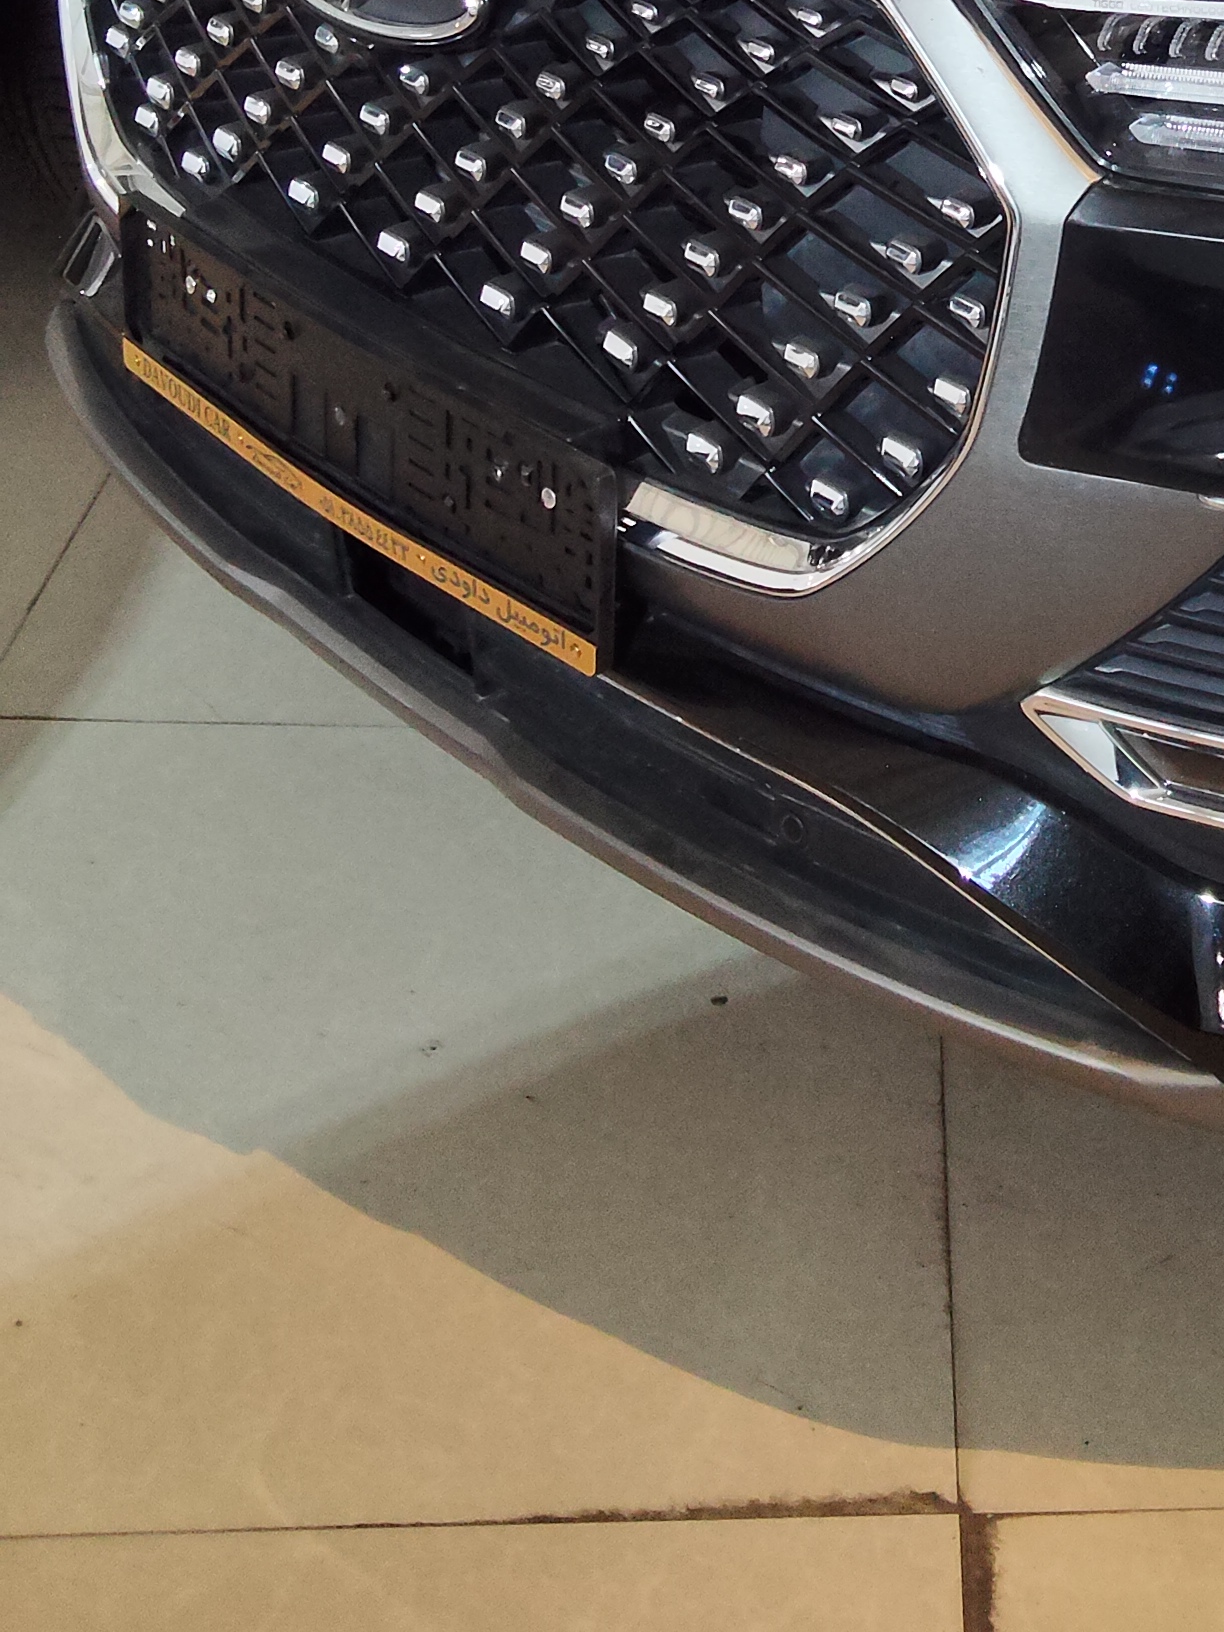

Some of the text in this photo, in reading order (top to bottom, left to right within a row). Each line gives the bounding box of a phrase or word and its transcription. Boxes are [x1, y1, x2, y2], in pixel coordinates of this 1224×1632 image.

[143, 356, 232, 442] DAVOUDI CAR
[431, 565, 566, 650] اتومبیل داودی
